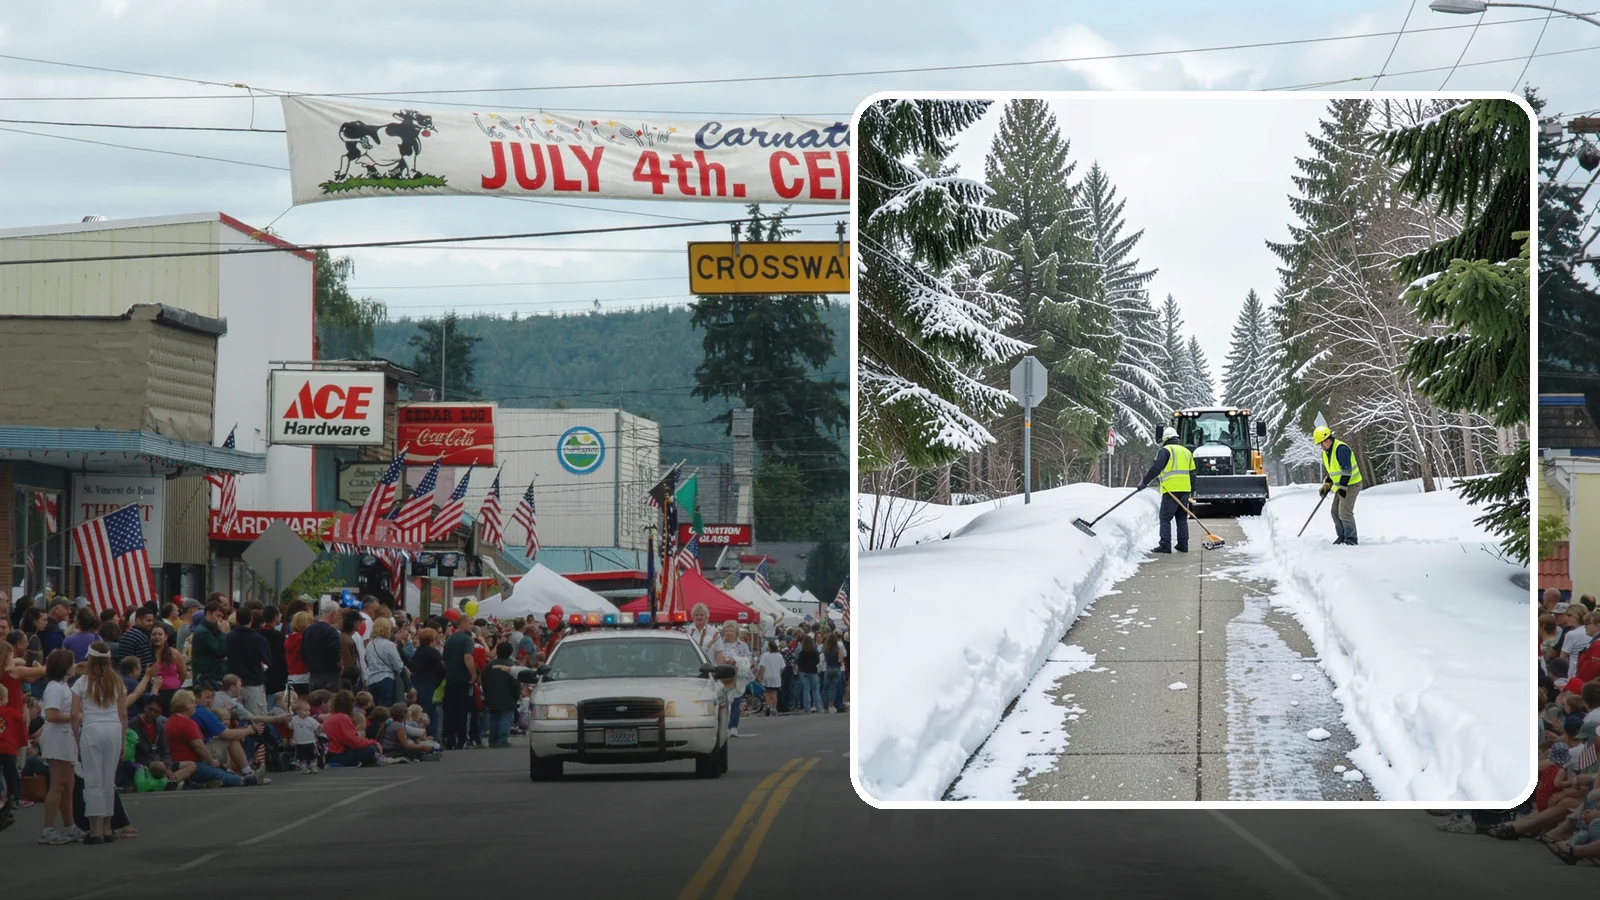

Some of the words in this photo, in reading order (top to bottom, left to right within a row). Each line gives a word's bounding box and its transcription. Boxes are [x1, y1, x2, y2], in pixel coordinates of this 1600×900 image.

[481, 141, 604, 192] JULY
[632, 150, 747, 198] 4th.
[696, 254, 850, 280] CROSSWA
[282, 380, 374, 420] ACE
[405, 409, 453, 422] CEDAR
[461, 409, 485, 422] LOG
[283, 421, 371, 437] Hardware
[416, 428, 477, 447] Coca-Cola
[96, 485, 124, 495] Vincent
[126, 486, 136, 495] de
[138, 486, 155, 495] Paul
[688, 526, 741, 535] CRNATION
[699, 535, 731, 544] GLASS
